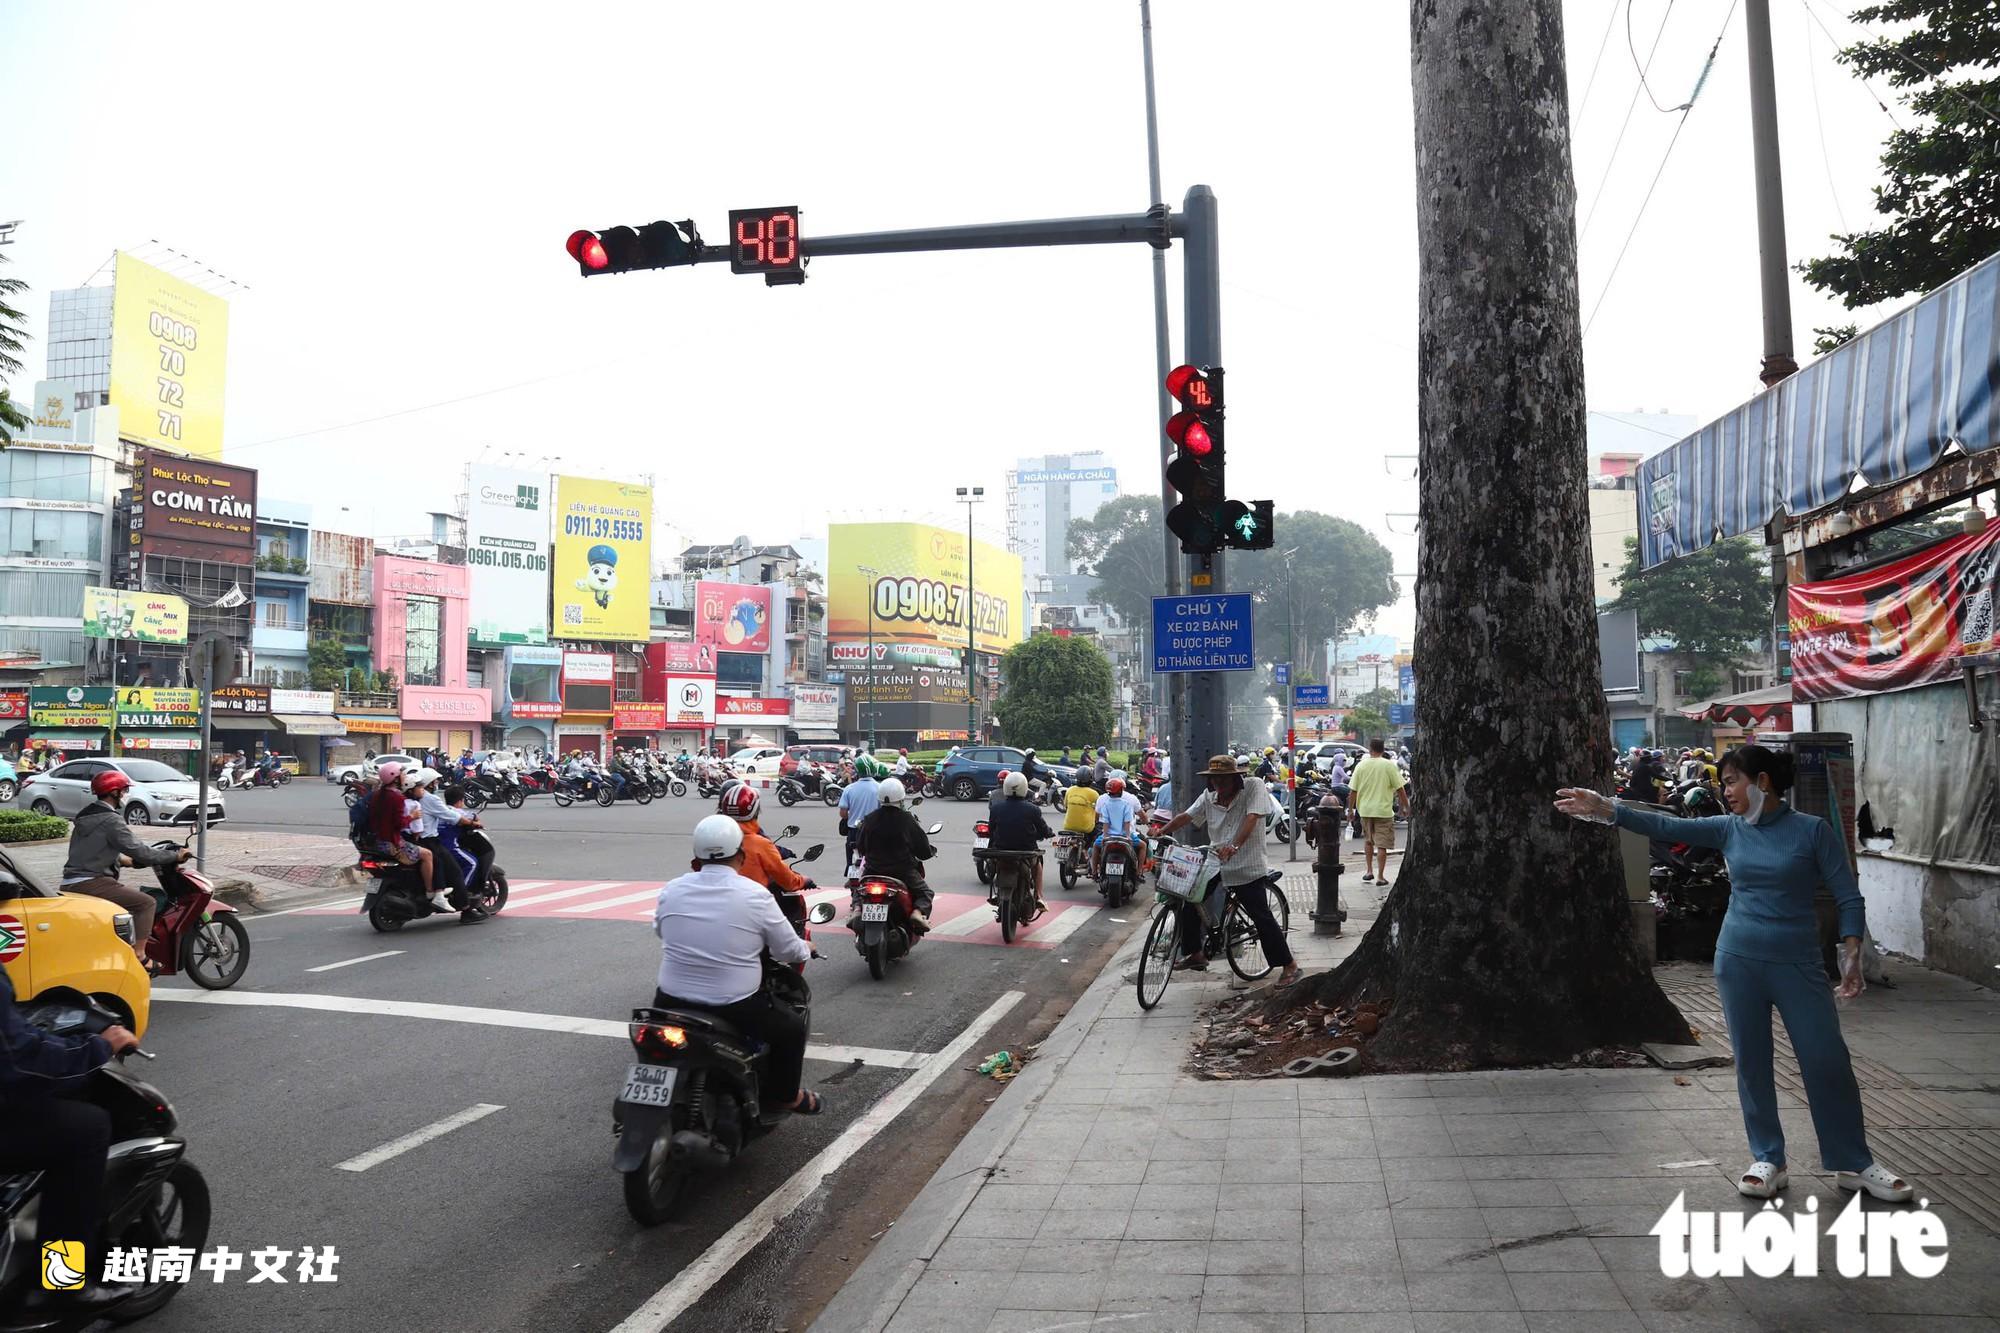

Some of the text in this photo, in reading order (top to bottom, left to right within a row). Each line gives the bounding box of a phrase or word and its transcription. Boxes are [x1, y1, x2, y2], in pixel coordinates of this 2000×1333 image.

[736, 214, 795, 267] 40
[149, 311, 197, 351] 0908
[159, 344, 185, 377] 70
[157, 376, 184, 408] 72
[157, 409, 182, 440] 71
[152, 467, 210, 488] Phúc Lộc Thọ
[1023, 470, 1110, 482] NGÂN HÀNG Á CHÂU
[152, 490, 253, 520] CƠM TẤM
[565, 514, 643, 542] 0911.39.5555
[467, 547, 546, 572] 0961.015.016
[147, 601, 166, 610] CÀNG
[1176, 598, 1228, 616] CHÚ Ý
[144, 615, 163, 626] CÀNG
[163, 612, 178, 620] MIX
[1167, 617, 1238, 633] XE 02 BÁNH
[1173, 633, 1232, 651] ĐƯỢC PHÉP
[833, 643, 887, 660] NHƯ Ý
[1158, 650, 1248, 667] ĐI THẲNG LIÊN TỤC
[882, 672, 913, 685] KÍNH
[226, 687, 241, 698] Lộc
[241, 688, 256, 698] Thọ
[83, 703, 105, 711] Ngon
[155, 703, 190, 711] 14.000
[244, 699, 257, 712] 39
[742, 702, 763, 712] MSB
[121, 713, 197, 725] RAU MÁ mix
[624, 1083, 669, 1103] 795.59
